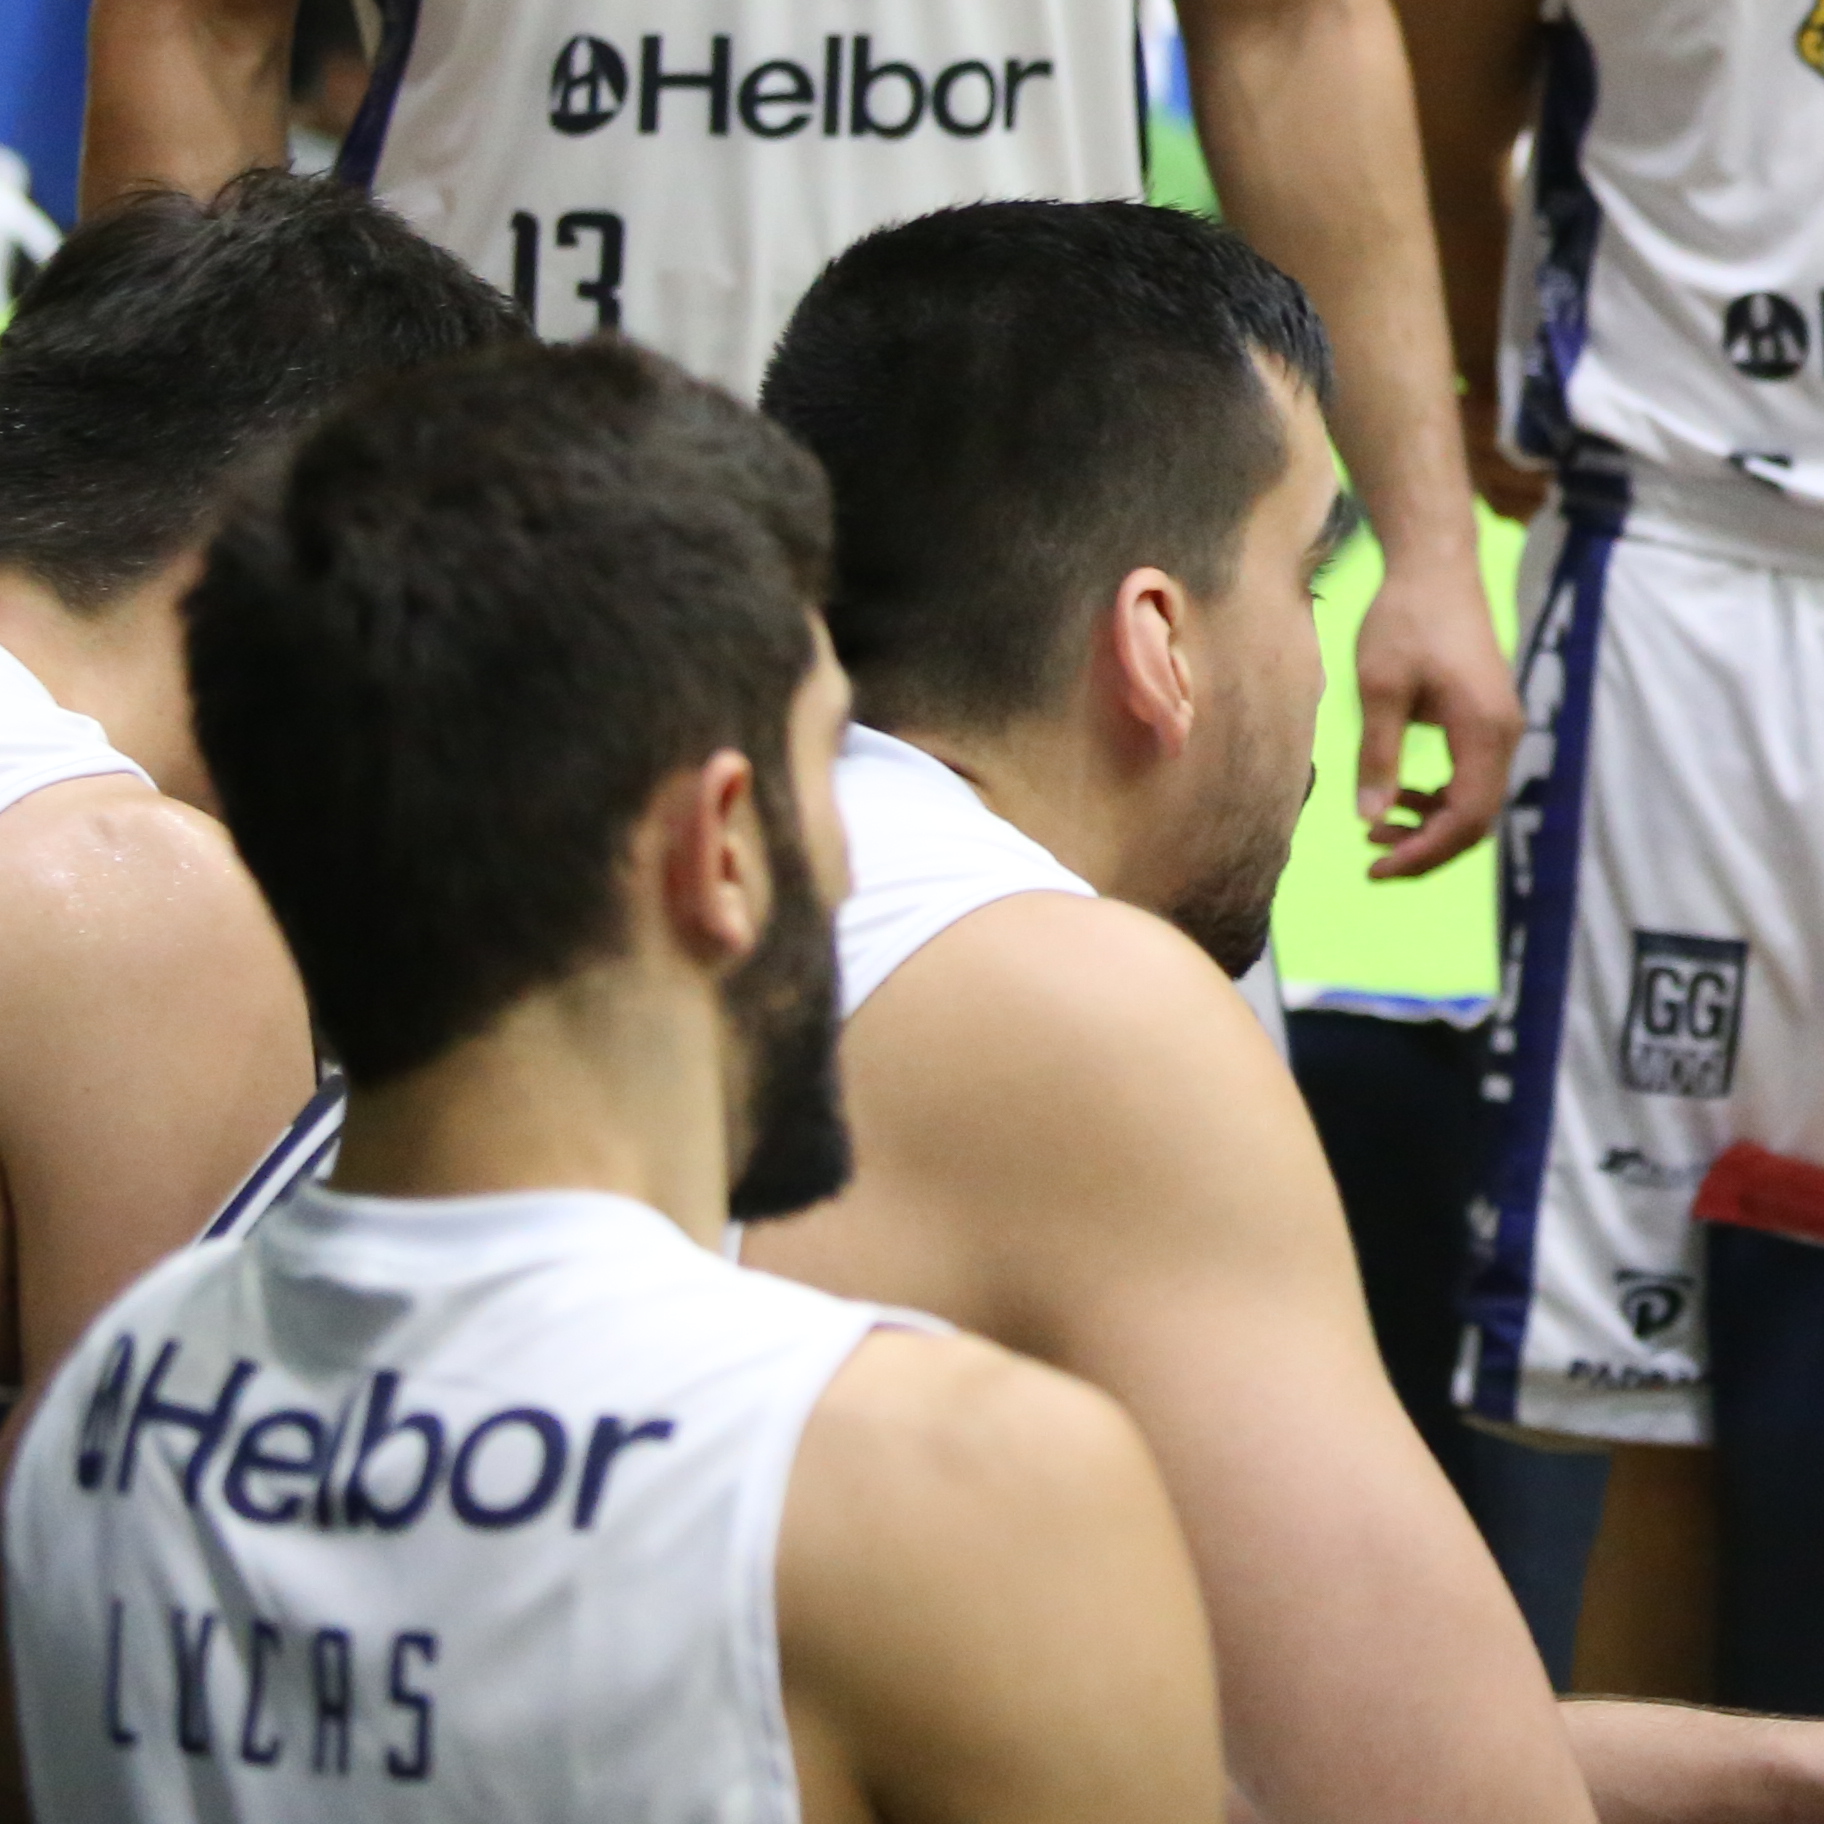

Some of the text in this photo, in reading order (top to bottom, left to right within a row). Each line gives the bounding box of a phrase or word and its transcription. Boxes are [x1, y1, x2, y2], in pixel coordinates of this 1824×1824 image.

[638, 34, 1052, 139] Helbor
[511, 211, 625, 336] 13
[1643, 968, 1726, 1038] GG
[114, 1338, 674, 1531] Helbor
[105, 1601, 438, 1778] LUCAS
